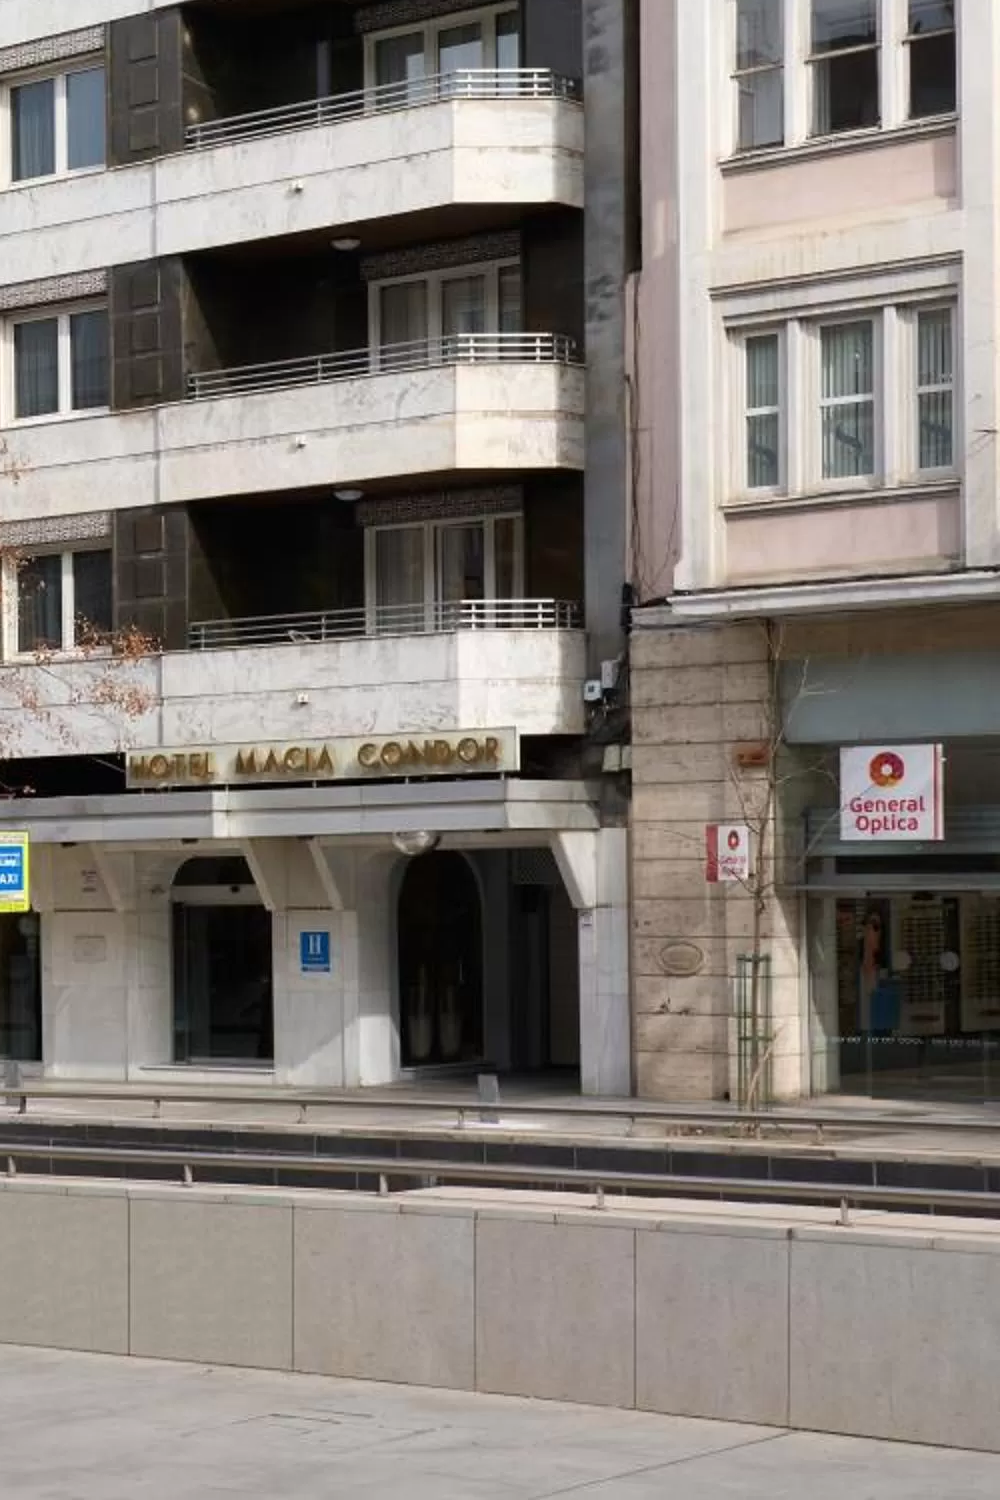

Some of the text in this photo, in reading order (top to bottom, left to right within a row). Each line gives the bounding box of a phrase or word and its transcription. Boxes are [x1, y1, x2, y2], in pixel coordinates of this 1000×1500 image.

[130, 736, 500, 780] HOTEL MACIA CONDOR
[850, 796, 924, 813] General
[855, 815, 918, 835] Optica
